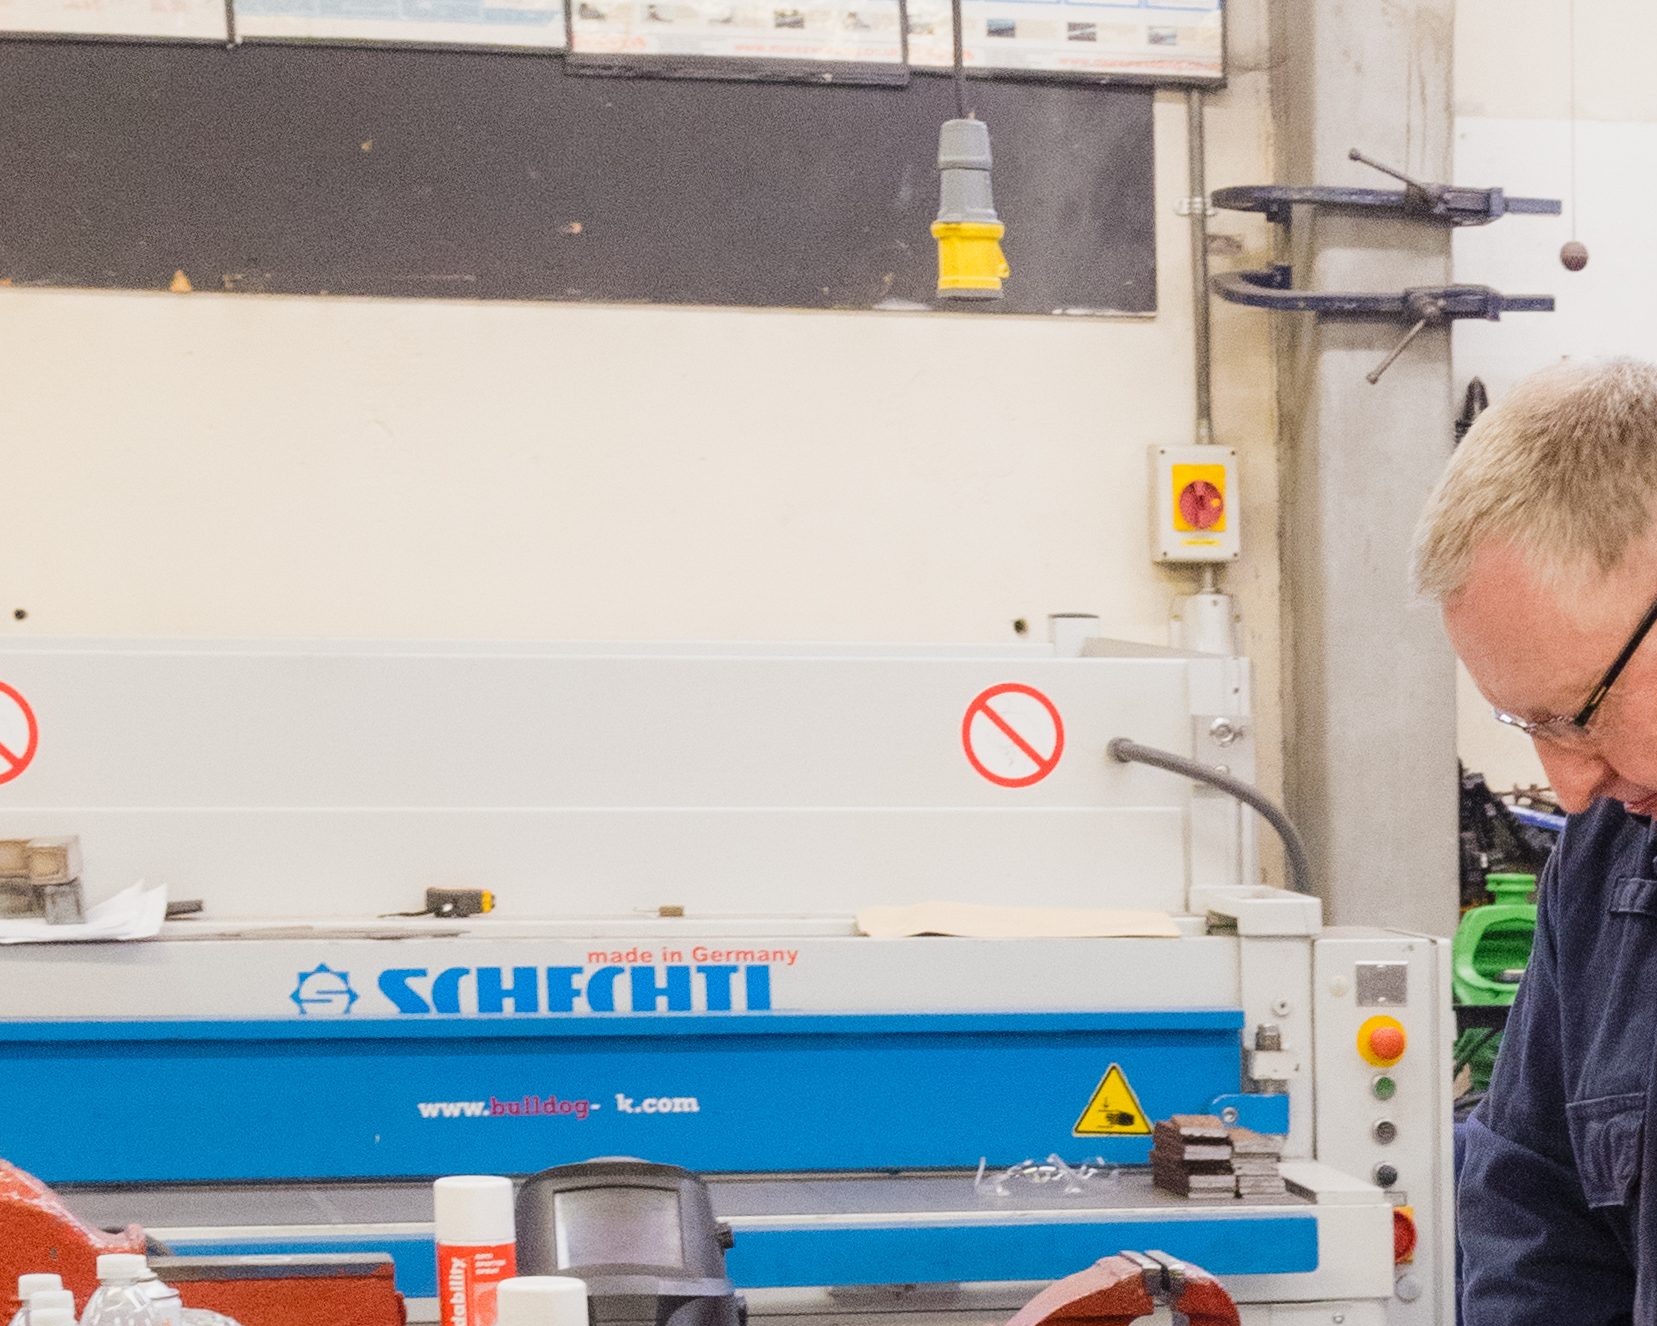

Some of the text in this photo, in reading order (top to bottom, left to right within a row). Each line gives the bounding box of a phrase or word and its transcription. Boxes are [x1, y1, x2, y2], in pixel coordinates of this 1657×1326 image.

[588, 946, 799, 966] made in Germany
